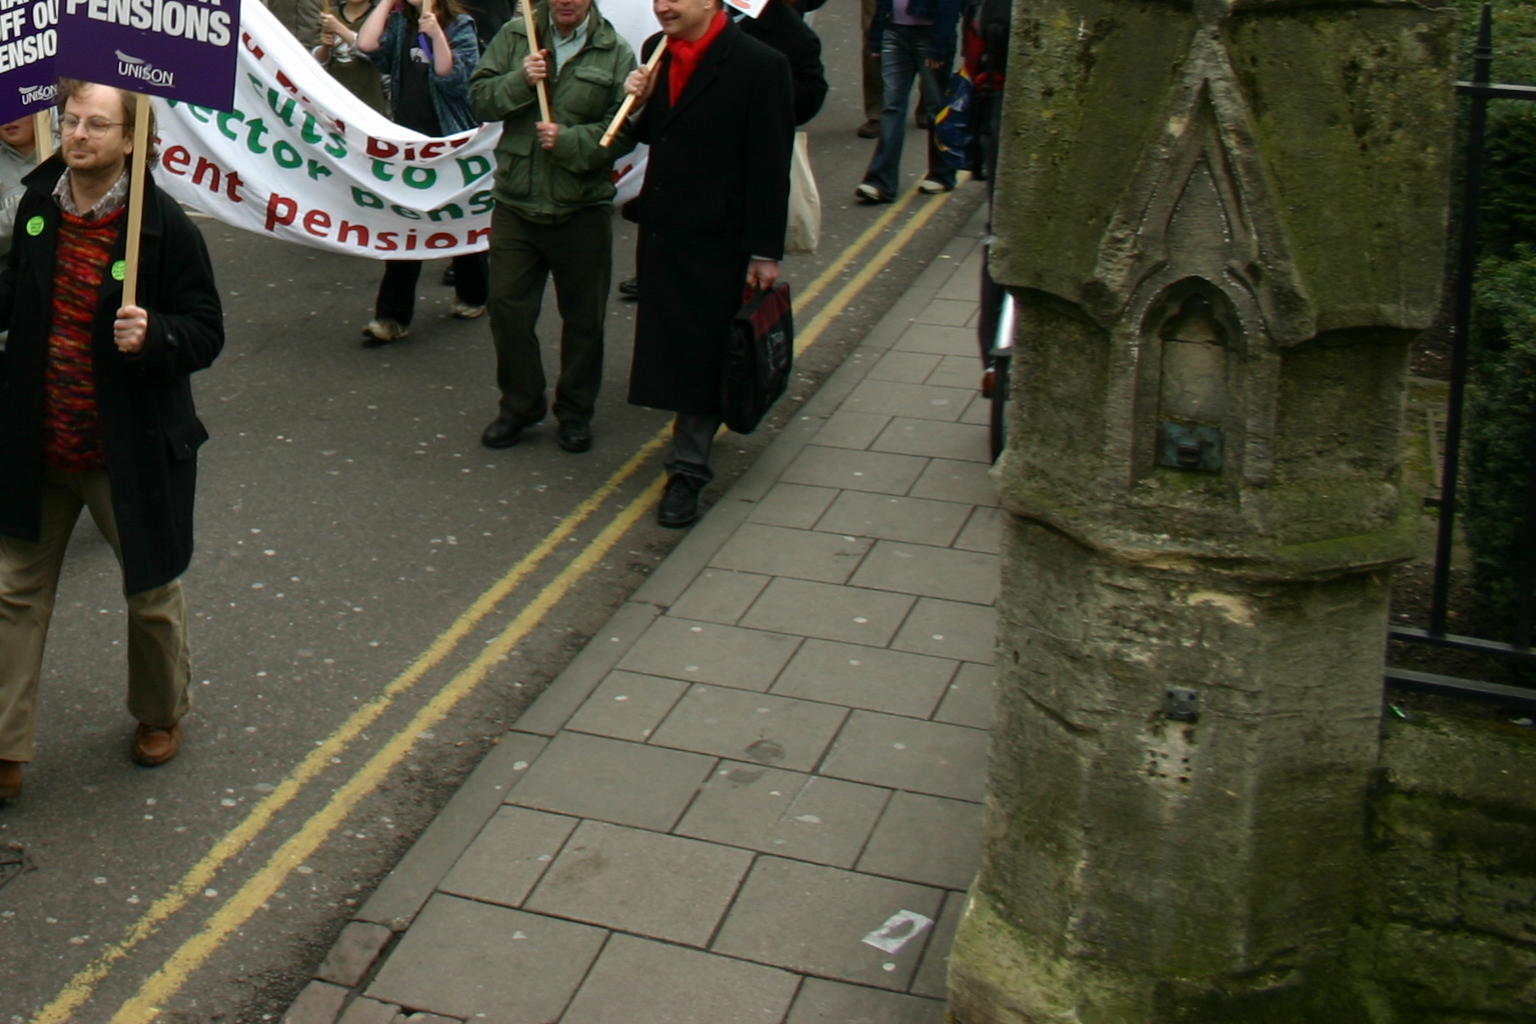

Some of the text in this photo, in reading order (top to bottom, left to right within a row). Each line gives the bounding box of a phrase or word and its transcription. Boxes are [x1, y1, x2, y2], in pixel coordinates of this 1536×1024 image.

[117, 61, 174, 86] UNISON
[21, 85, 58, 106] UNISON
[371, 157, 437, 190] to
